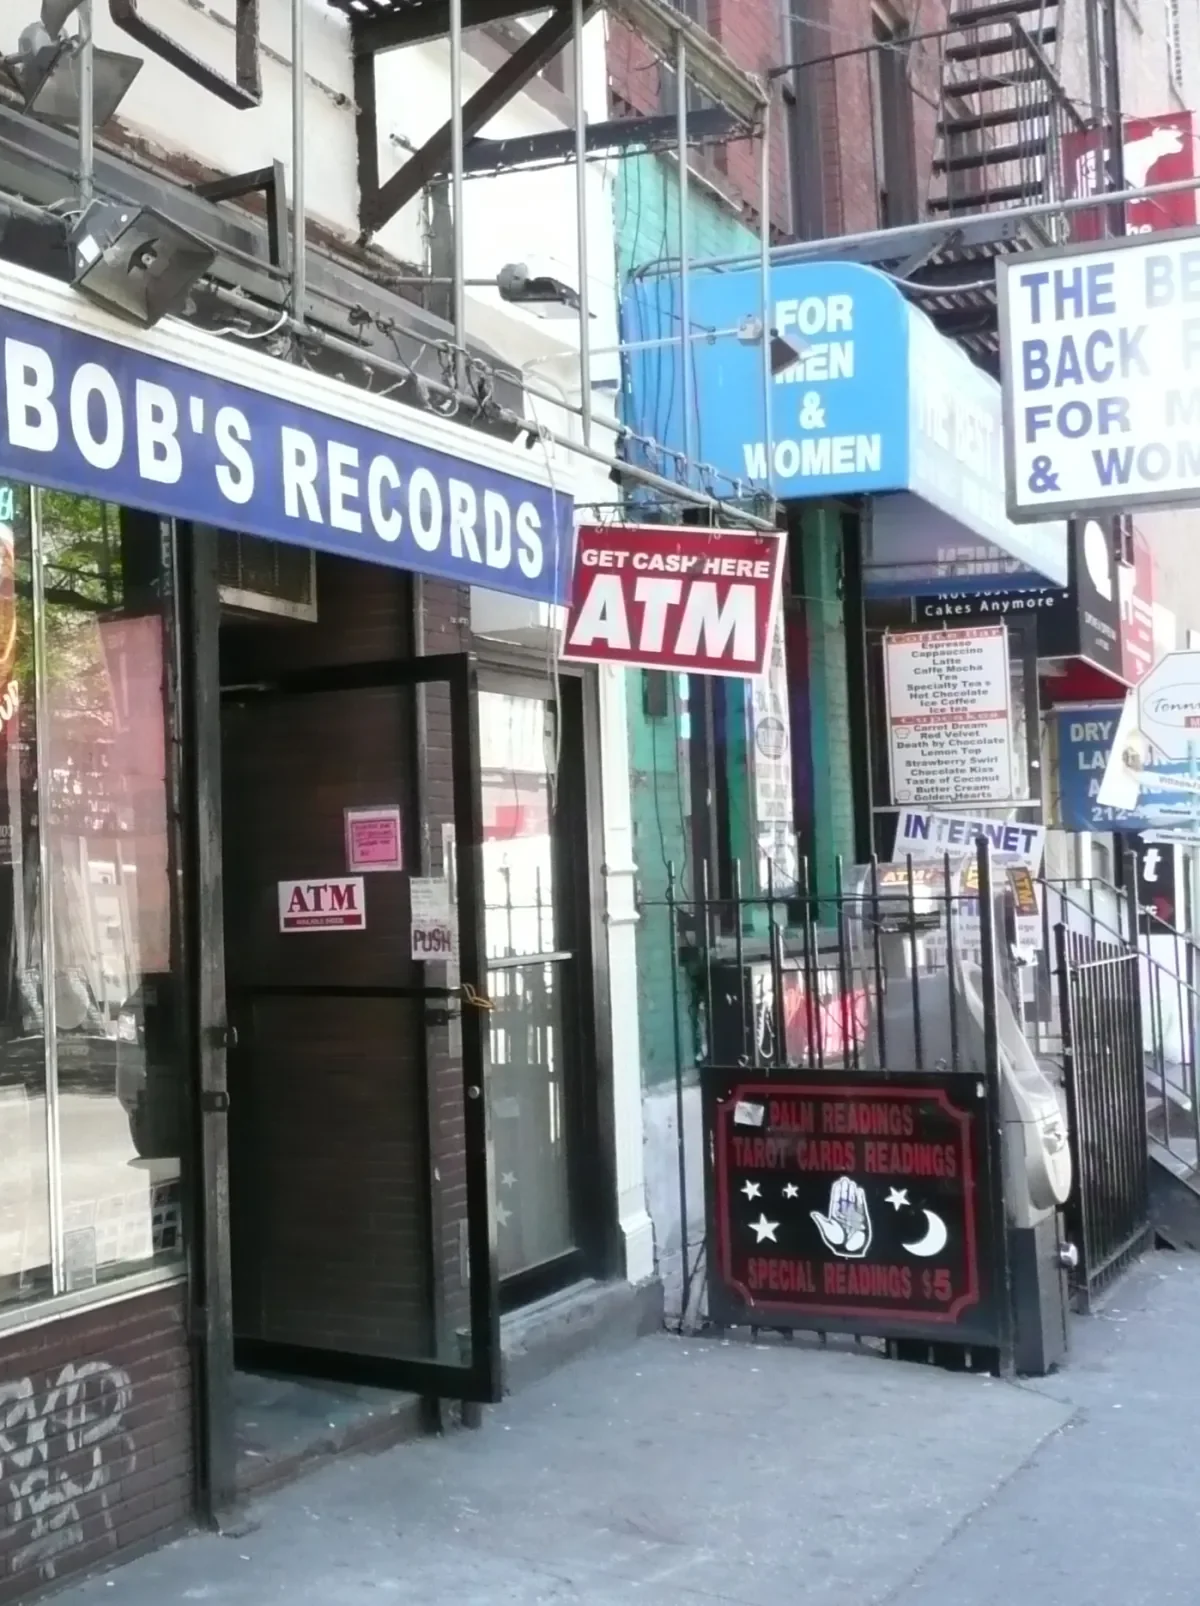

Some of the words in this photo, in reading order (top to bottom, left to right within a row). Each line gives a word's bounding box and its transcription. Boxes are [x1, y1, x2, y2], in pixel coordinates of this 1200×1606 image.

[1020, 262, 1116, 324] THE
[776, 295, 853, 336] FOR
[1022, 324, 1150, 391] BACK
[799, 391, 825, 429] &
[1025, 396, 1131, 443] FOR
[4, 336, 255, 504] BOB'S
[281, 426, 542, 579] RECORDS
[743, 434, 881, 479] WOMEN
[1028, 455, 1061, 493] &
[581, 549, 629, 569] GET
[632, 552, 698, 573] CASH
[703, 557, 770, 579] HERE
[569, 574, 756, 661] ATM
[925, 604, 972, 616] Cakes
[980, 597, 1055, 613] Anymore
[946, 665, 983, 673] Mocha
[932, 690, 988, 698] Chocolate
[944, 730, 980, 738] Velvet
[948, 738, 1005, 747] Chocolate
[1070, 722, 1112, 742] DRY
[910, 768, 966, 776] Chocolate
[904, 814, 1038, 853] INTERNET
[287, 884, 357, 912] ATM
[413, 928, 452, 952] PUSH
[770, 1102, 814, 1132] PALM
[822, 1102, 914, 1135] READINGS
[732, 1137, 788, 1168] TAROT
[795, 1141, 855, 1171] CARDS
[865, 1142, 956, 1177] READINGS
[748, 1258, 816, 1292] SPECIAL
[824, 1263, 912, 1299] READINGS
[922, 1268, 952, 1301] $5
